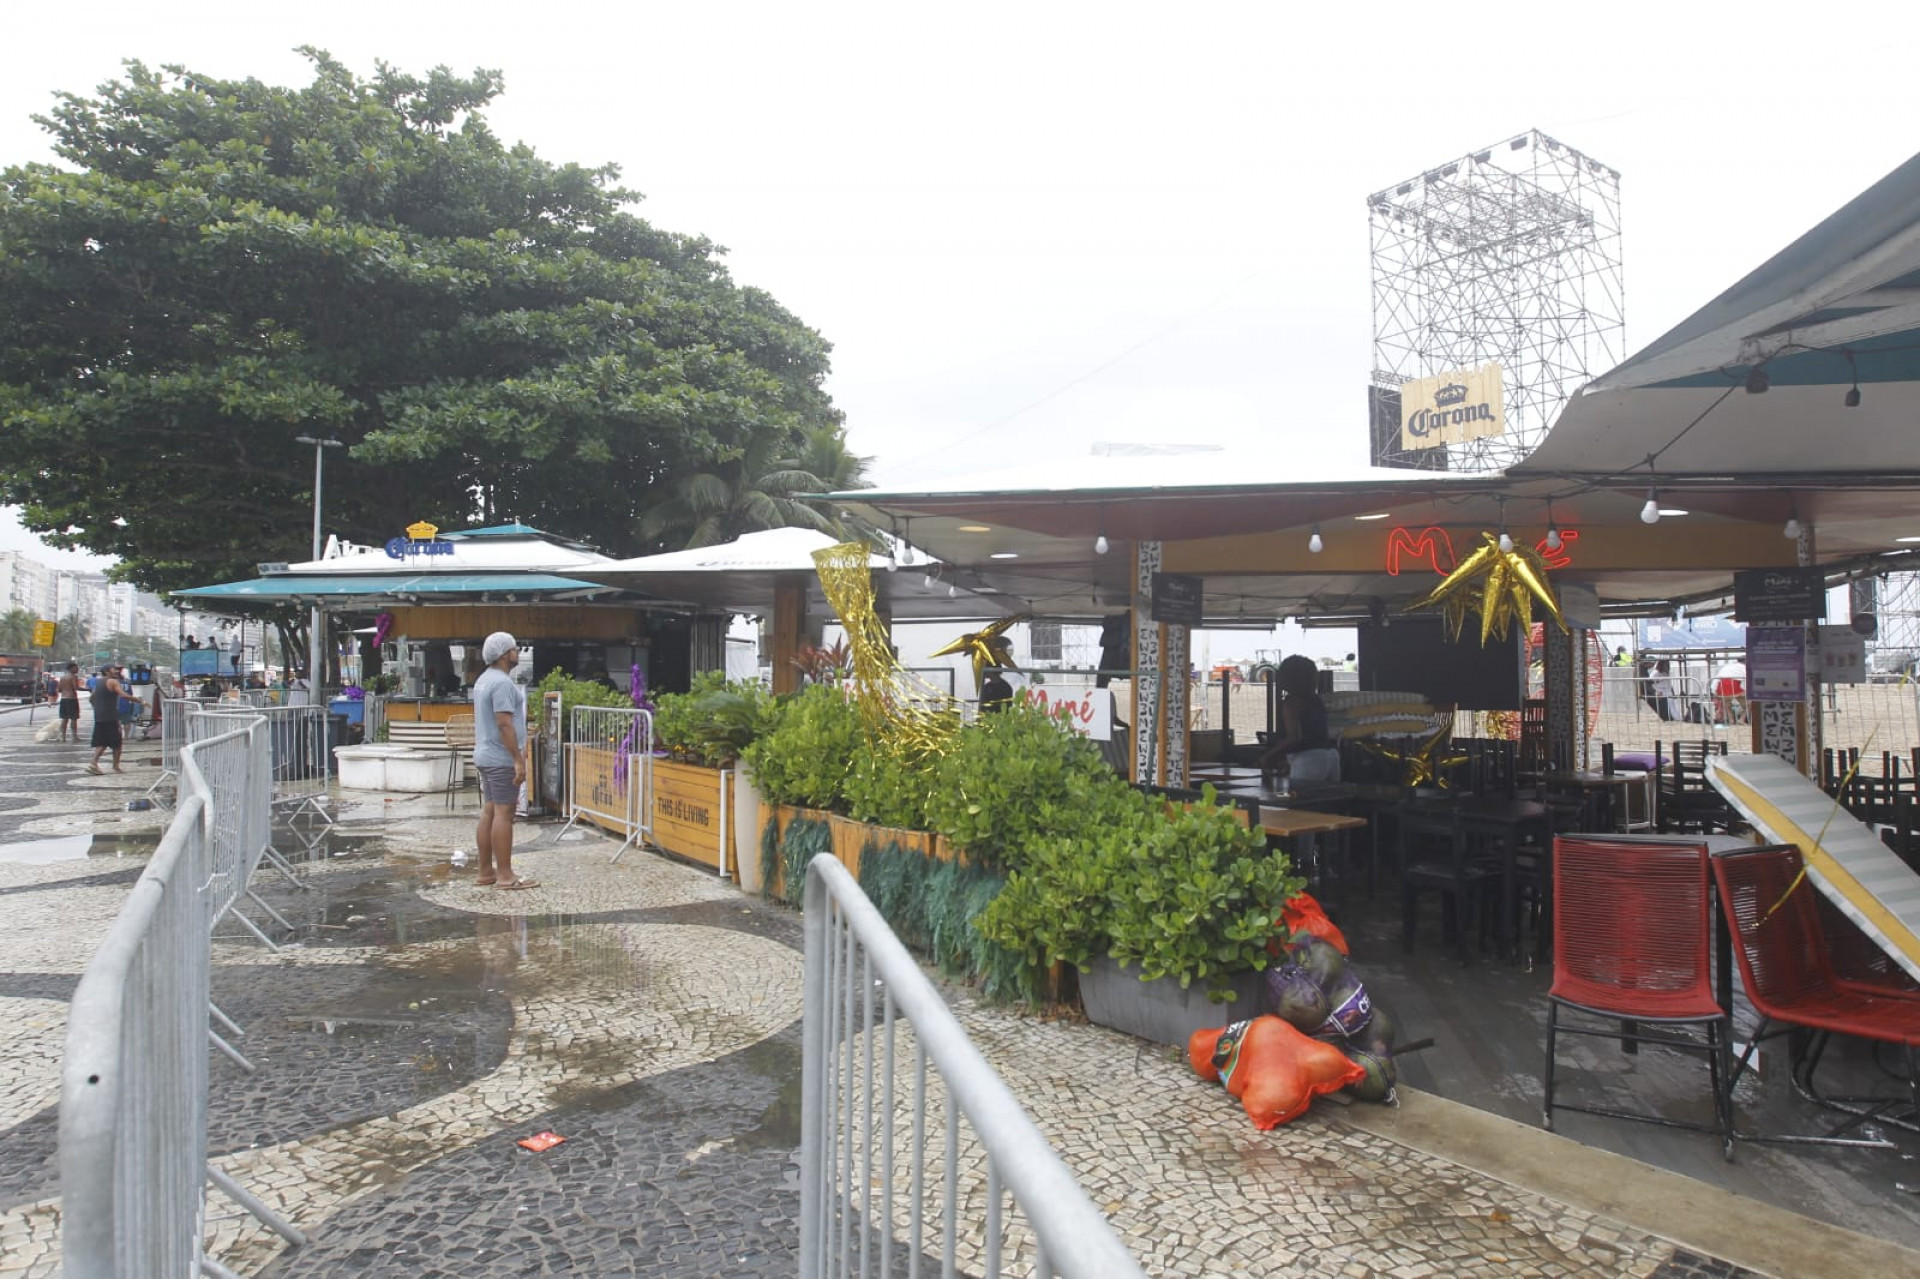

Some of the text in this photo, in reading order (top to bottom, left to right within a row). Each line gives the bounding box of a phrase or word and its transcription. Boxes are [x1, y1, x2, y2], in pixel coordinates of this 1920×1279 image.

[1408, 402, 1495, 438] Corona
[658, 797, 709, 827] THIS IS LIVING
